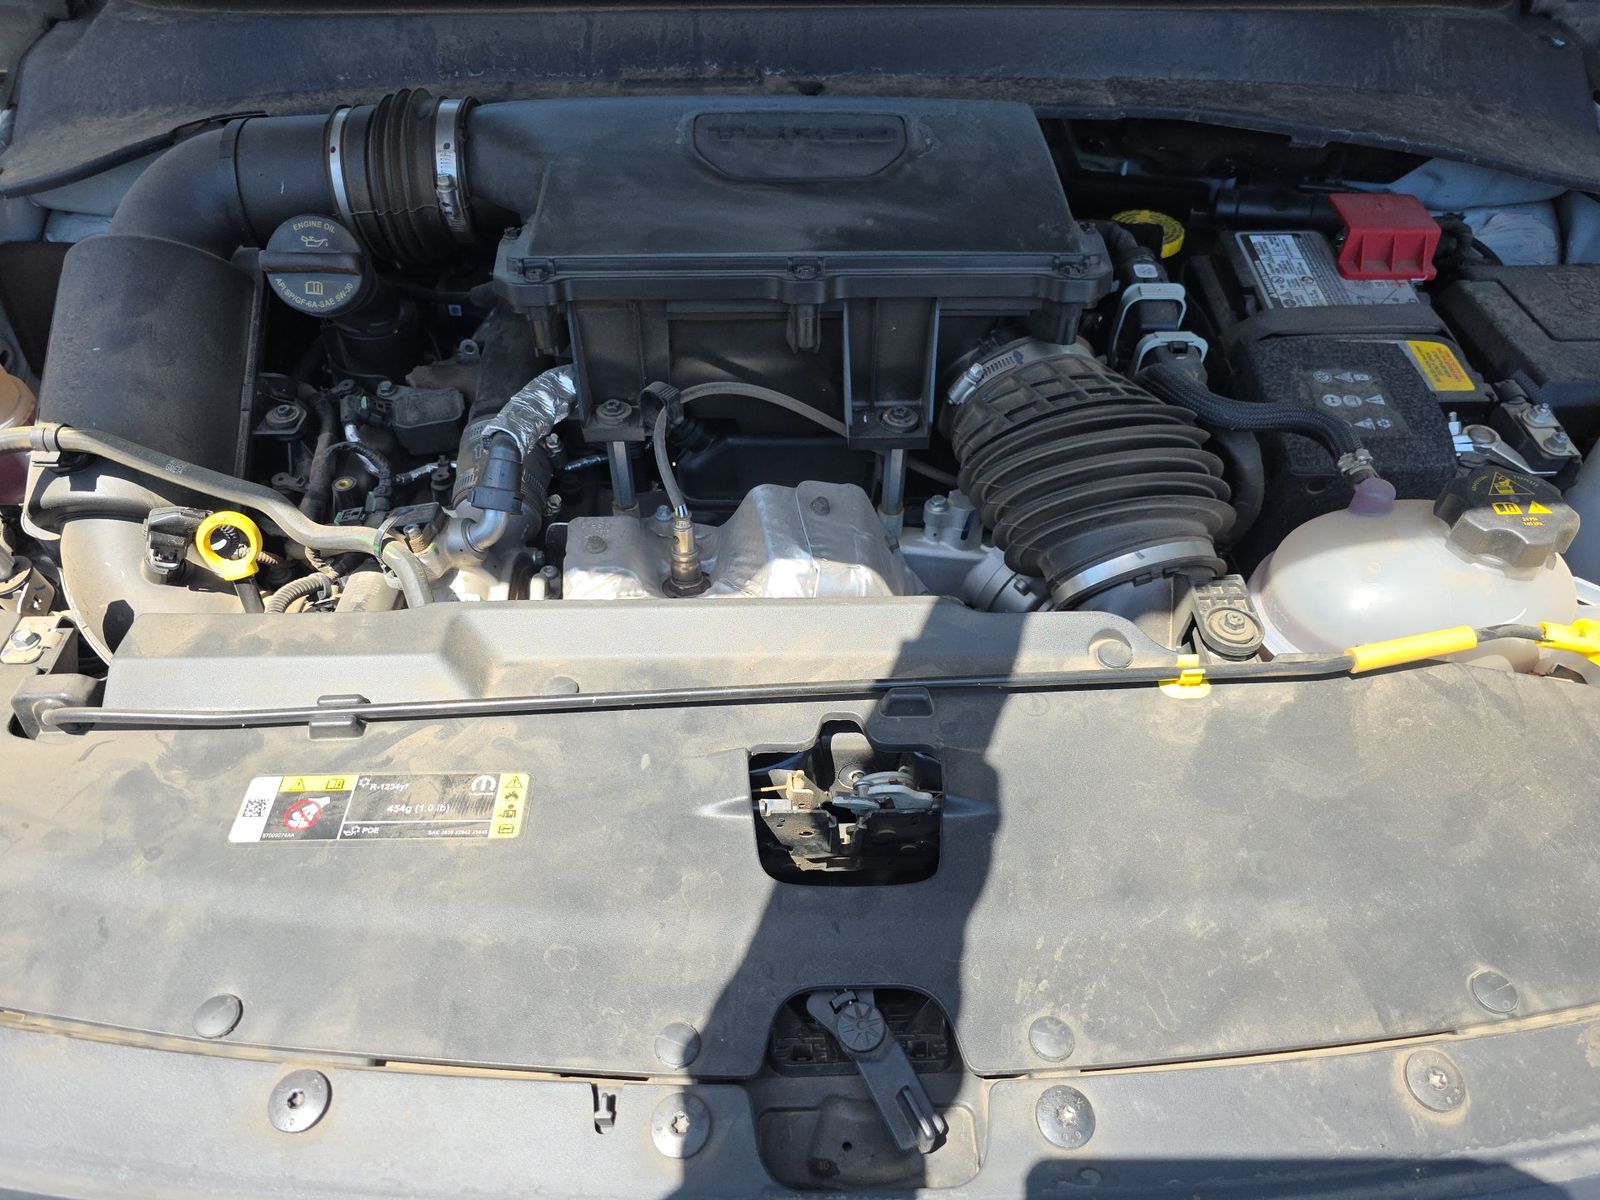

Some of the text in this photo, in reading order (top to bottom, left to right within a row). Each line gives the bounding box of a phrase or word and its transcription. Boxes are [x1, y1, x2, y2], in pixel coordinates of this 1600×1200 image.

[293, 220, 336, 234] ENGINE OIL
[369, 783, 409, 792] R-1234yf
[386, 803, 450, 815] 454g (1.0 lb)
[361, 826, 380, 834] POE
